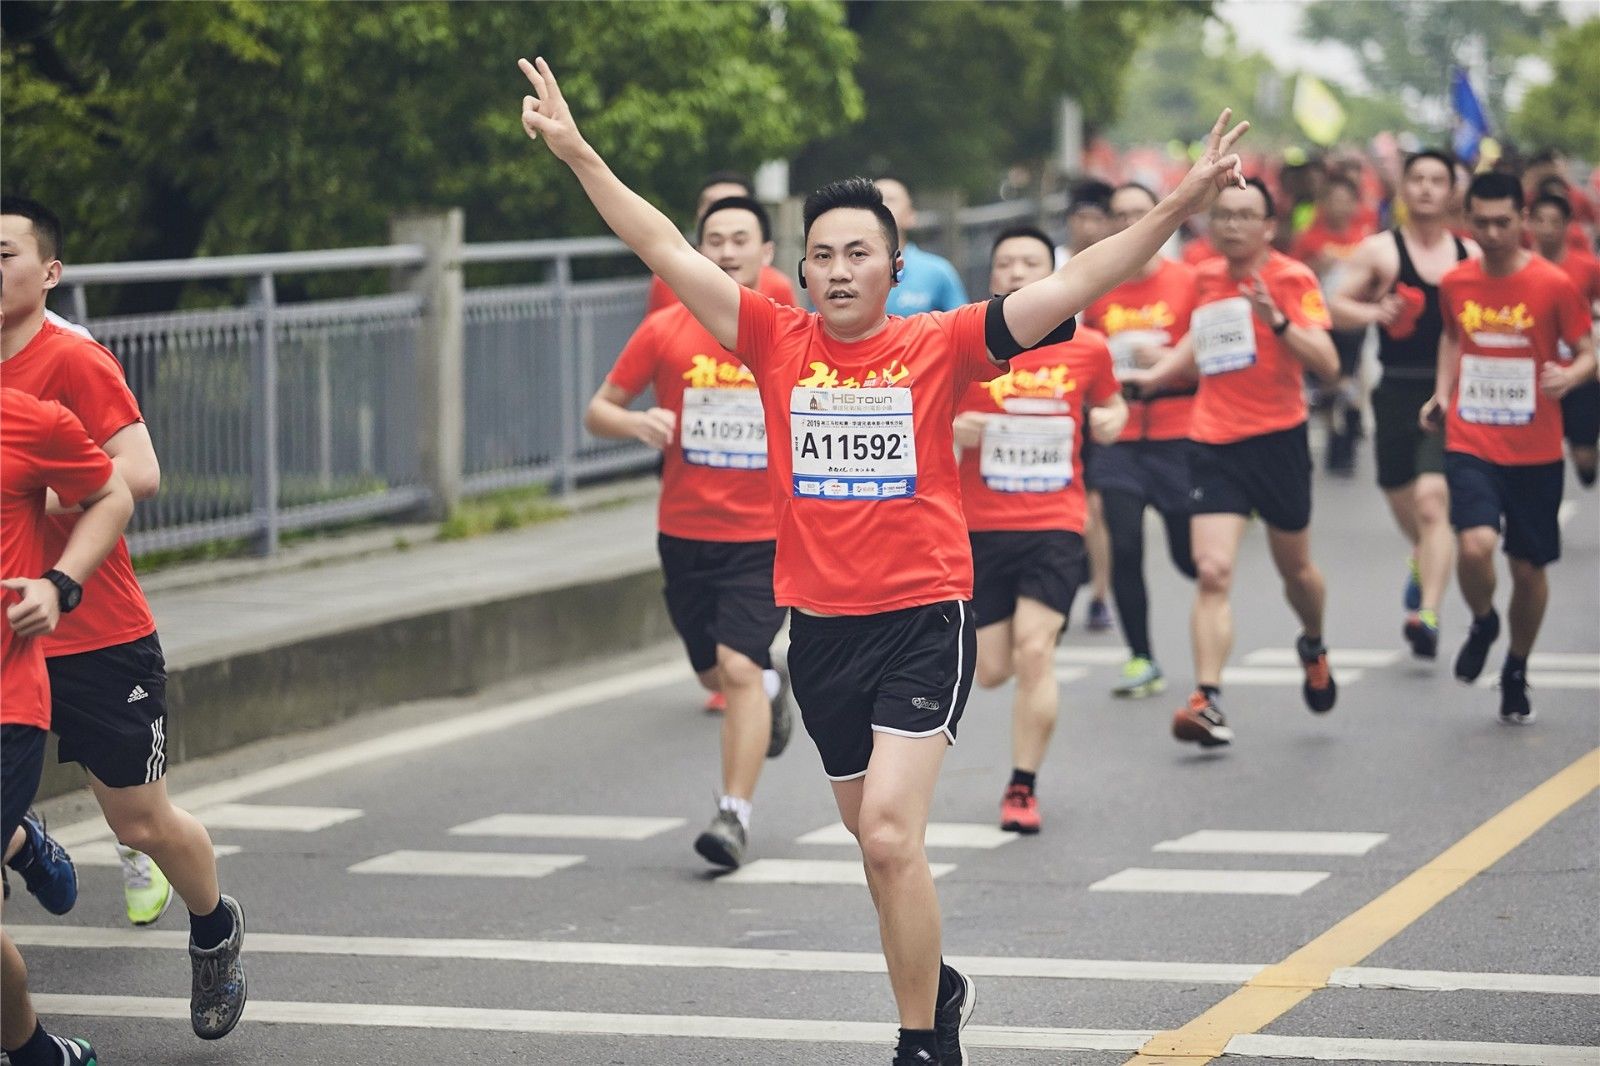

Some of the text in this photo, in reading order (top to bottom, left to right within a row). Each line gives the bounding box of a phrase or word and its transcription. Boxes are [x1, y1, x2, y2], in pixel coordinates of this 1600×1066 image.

[806, 419, 821, 428] 2019
[801, 432, 902, 460] A11592
[127, 692, 149, 703] adidas
